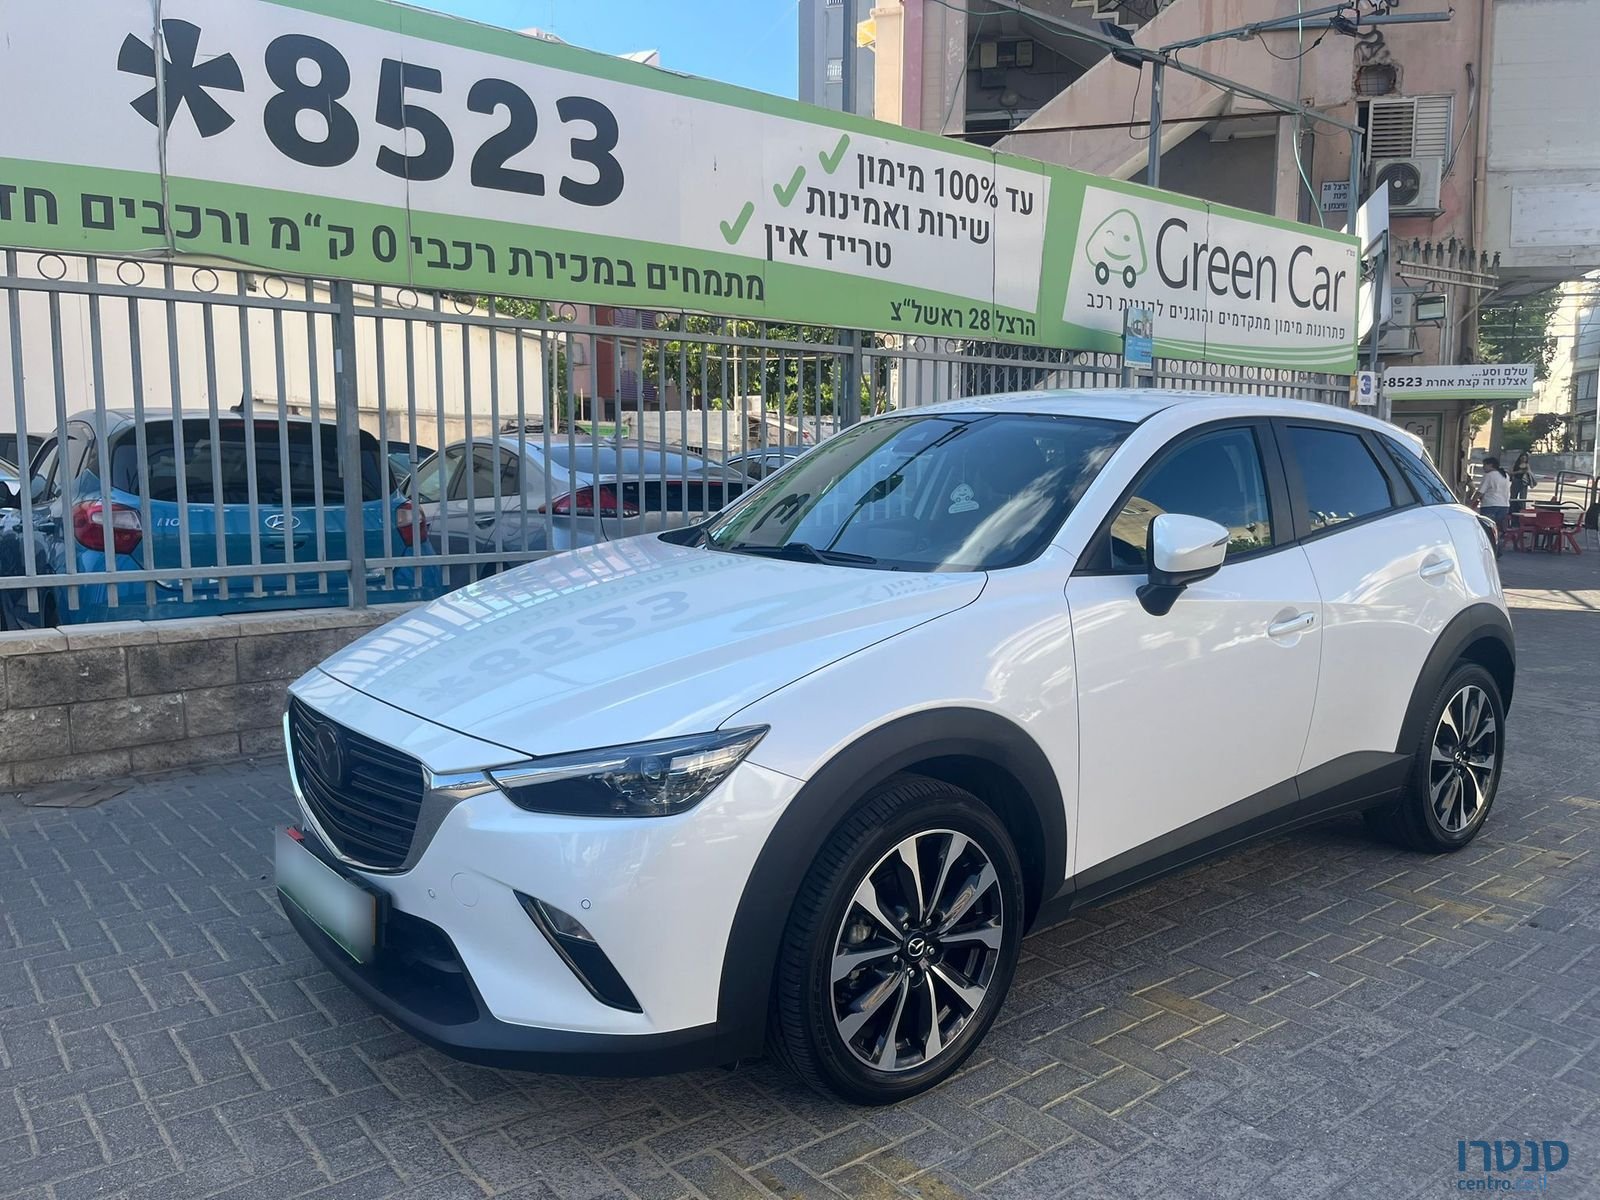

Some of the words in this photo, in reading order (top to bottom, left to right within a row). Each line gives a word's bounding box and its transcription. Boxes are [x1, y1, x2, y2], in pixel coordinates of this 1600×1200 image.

[857, 153, 925, 193] מימון
[934, 167, 999, 209] 100%
[805, 186, 909, 232] ואמינות
[1005, 186, 1034, 216] עד
[81, 193, 250, 246] ורכבים
[917, 207, 990, 245] שירות
[371, 224, 398, 263] 0
[410, 235, 497, 274] רכבי
[764, 223, 809, 262] אין
[818, 231, 892, 269] טרייד
[508, 246, 636, 288] במכירת
[1156, 218, 1277, 303] Green
[1288, 245, 1346, 312] Car
[646, 262, 765, 301] מתמחים
[1087, 292, 1113, 310] רכב
[1169, 304, 1213, 323] והוגנים
[968, 307, 991, 331] 28
[995, 309, 1036, 337] הרצל
[1219, 311, 1270, 332] מתקדמים
[1275, 319, 1302, 336] מימון
[1306, 322, 1345, 340] פתרונות
[1425, 378, 1454, 388] אחרת
[1457, 378, 1480, 389] קצת
[1483, 378, 1495, 387] זה
[1497, 376, 1528, 386] אצלנו
[1504, 367, 1528, 377] שלם
